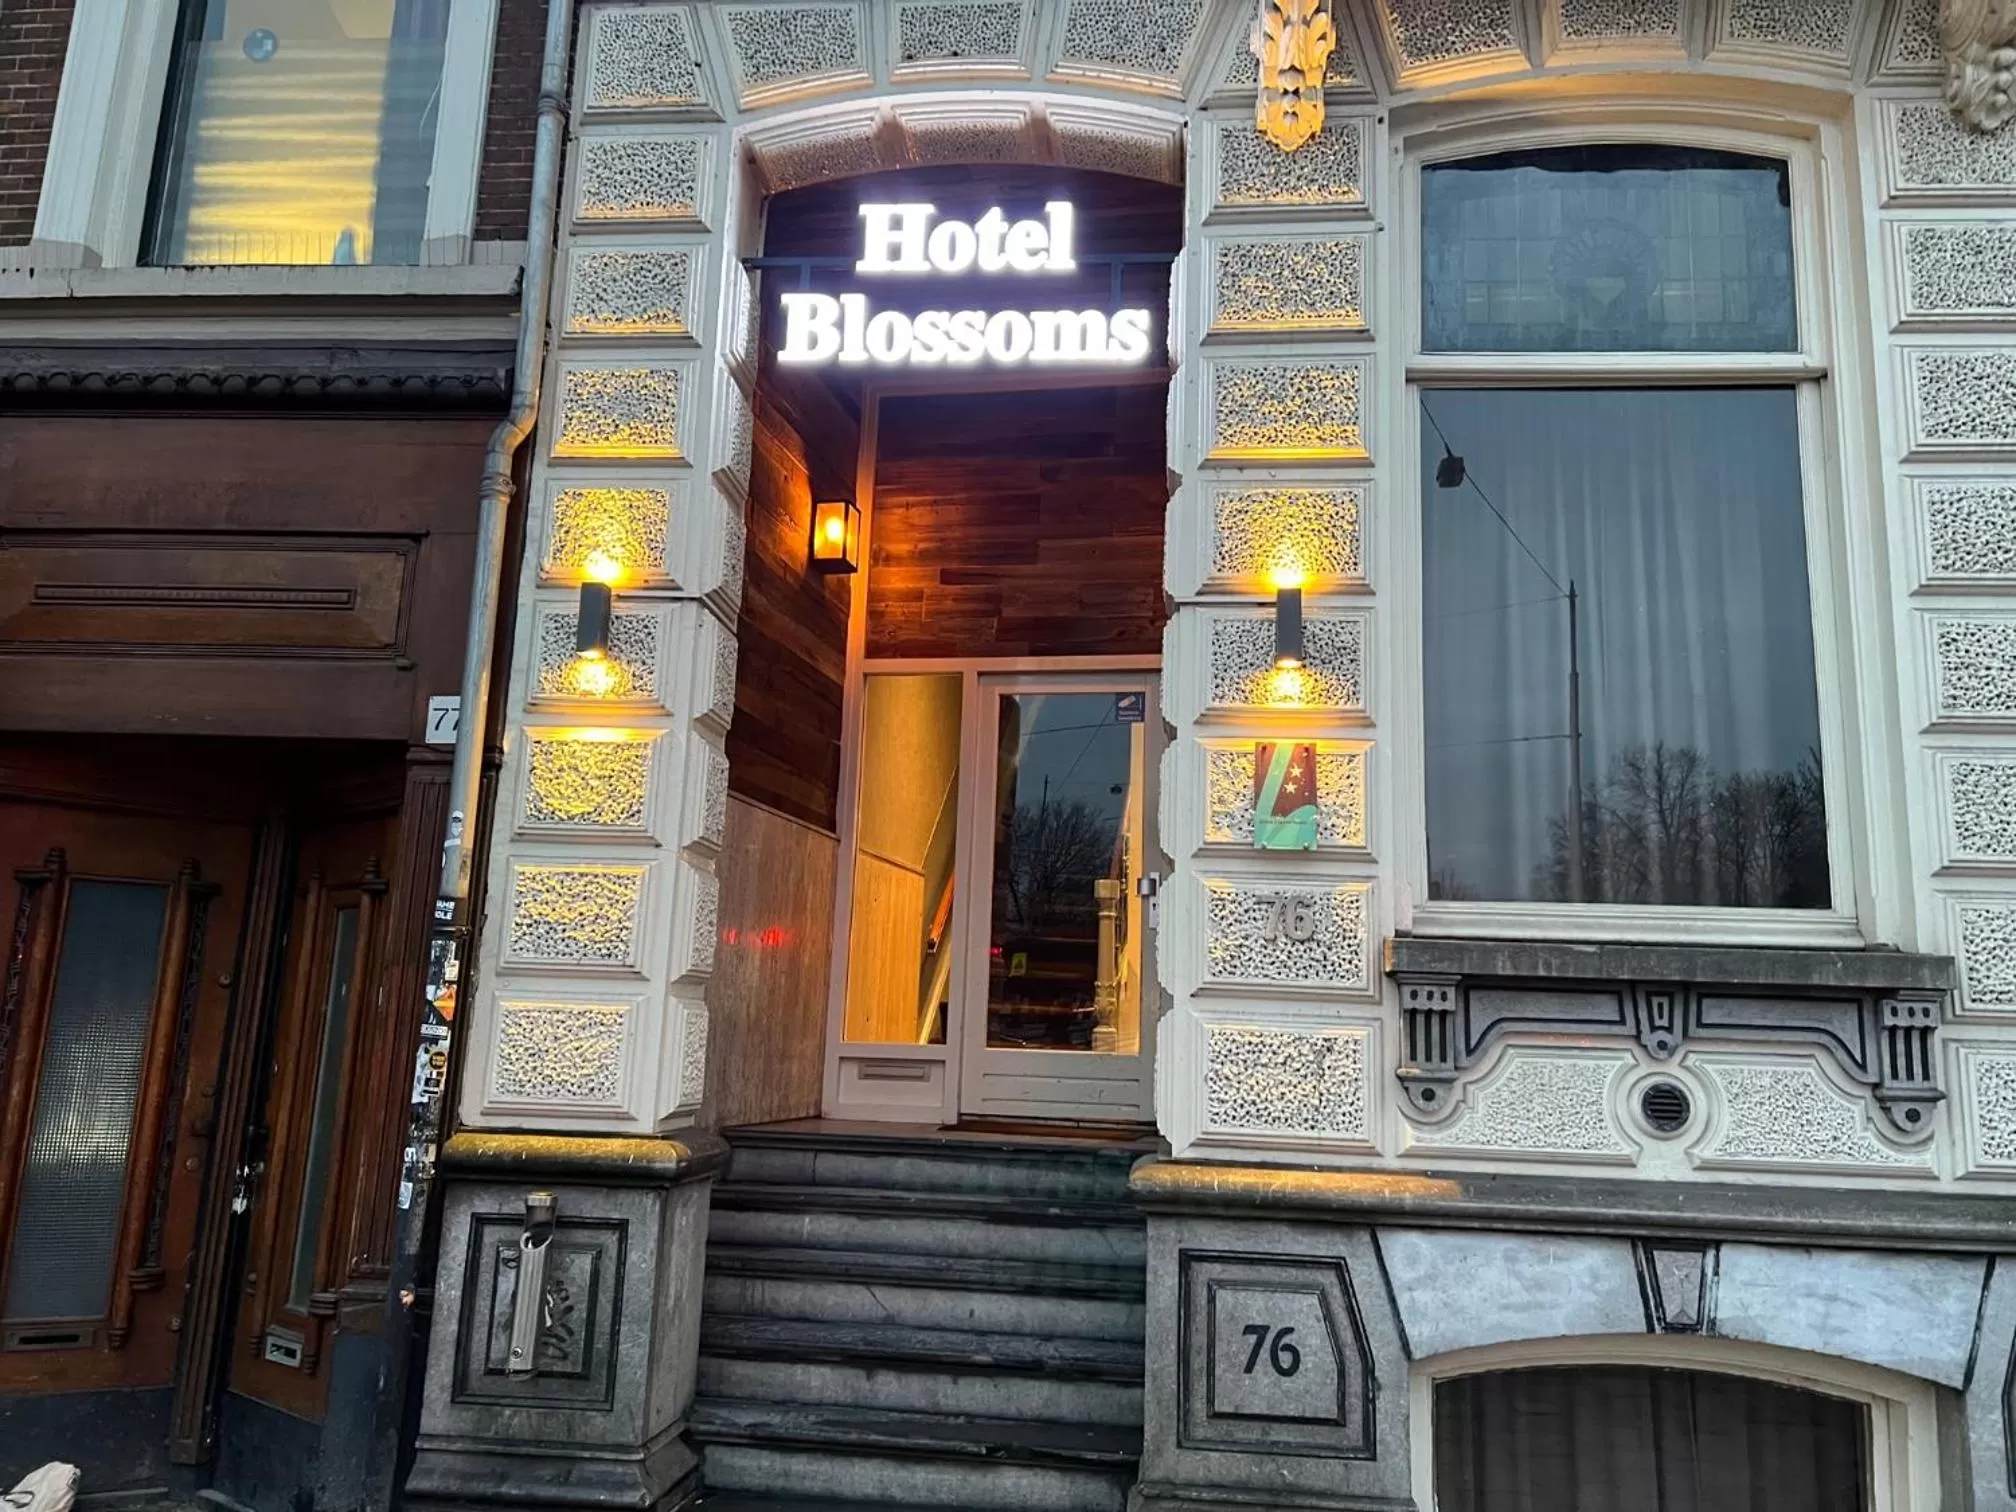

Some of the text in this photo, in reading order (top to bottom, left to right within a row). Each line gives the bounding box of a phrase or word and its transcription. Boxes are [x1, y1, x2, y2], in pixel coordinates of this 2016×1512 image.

[855, 201, 1077, 272] Hotel
[777, 293, 1152, 363] Blossoms
[1253, 895, 1314, 941] 76
[1242, 1324, 1300, 1377] 76
